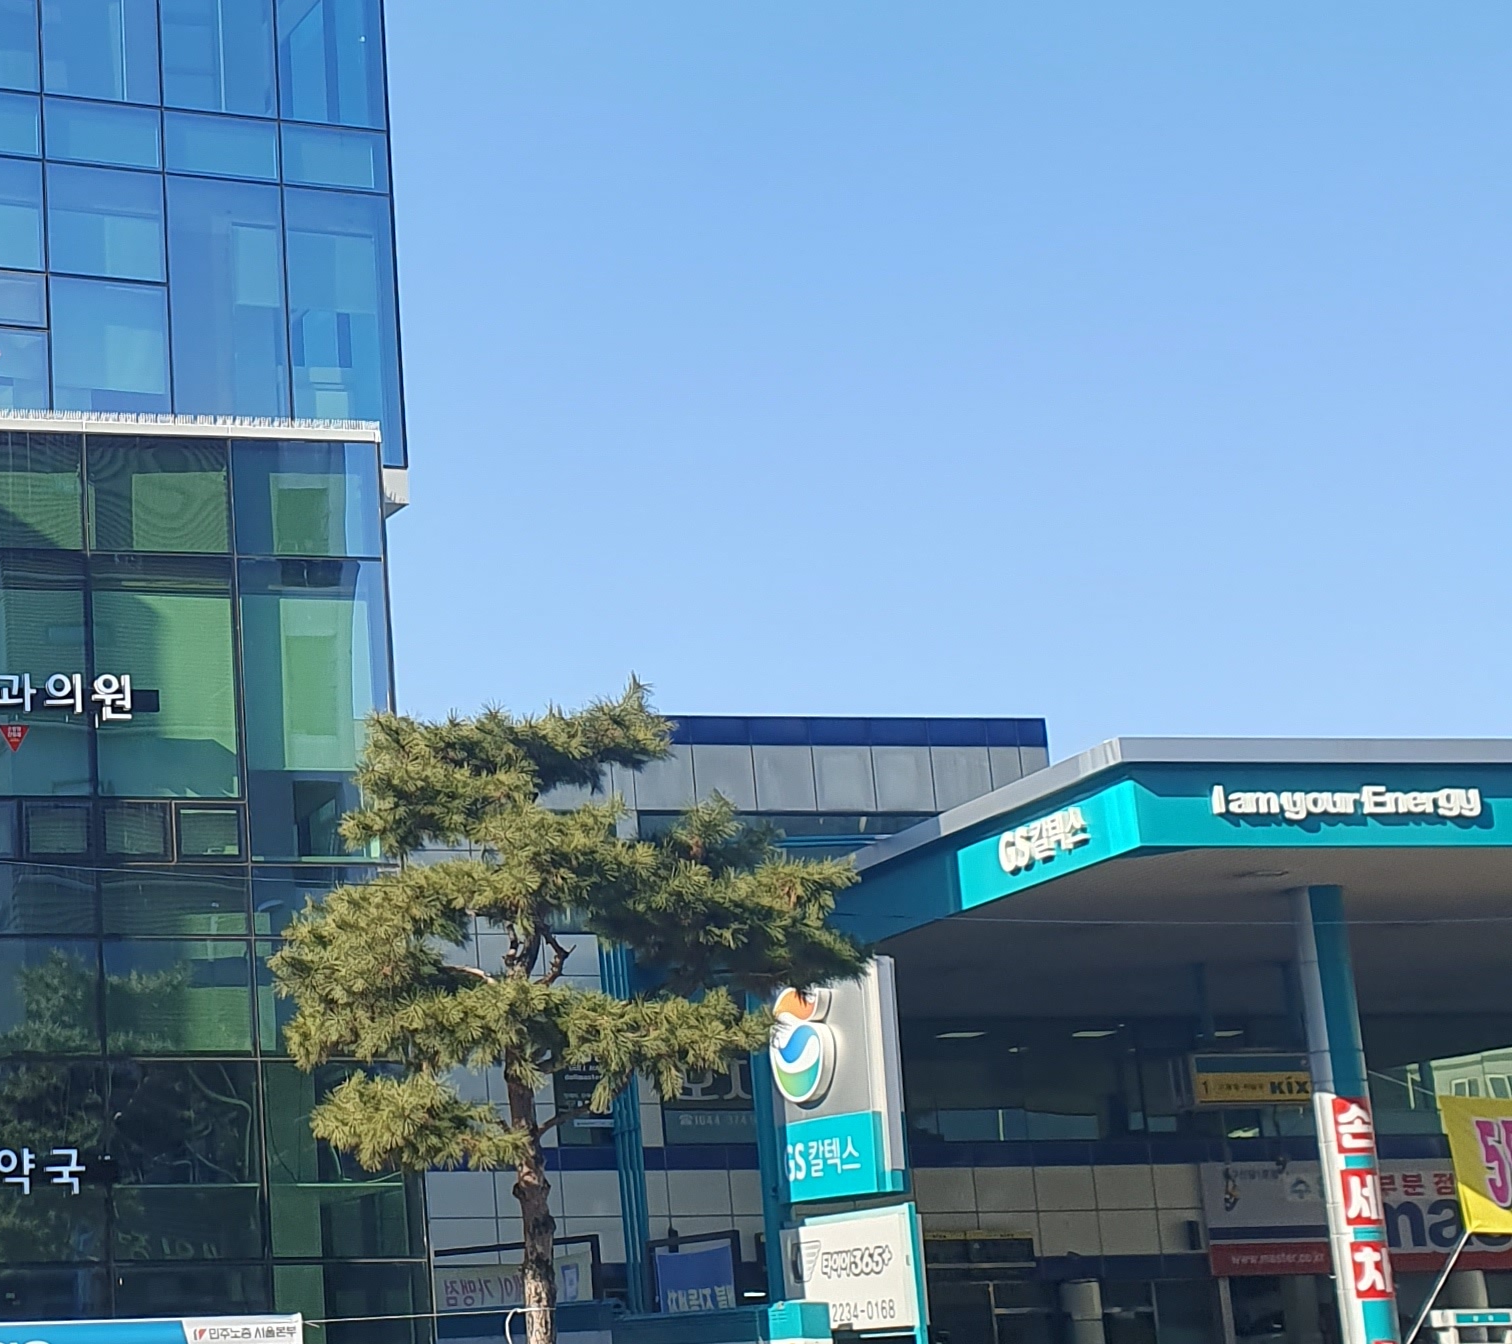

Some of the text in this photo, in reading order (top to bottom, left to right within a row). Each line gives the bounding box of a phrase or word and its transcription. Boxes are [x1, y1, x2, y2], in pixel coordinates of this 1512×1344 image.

[1212, 785, 1483, 820] I am your Energy
[1473, 1120, 1512, 1208] 5
[1338, 1103, 1392, 1293] 손세차
[832, 1299, 896, 1323] 2234-0168
